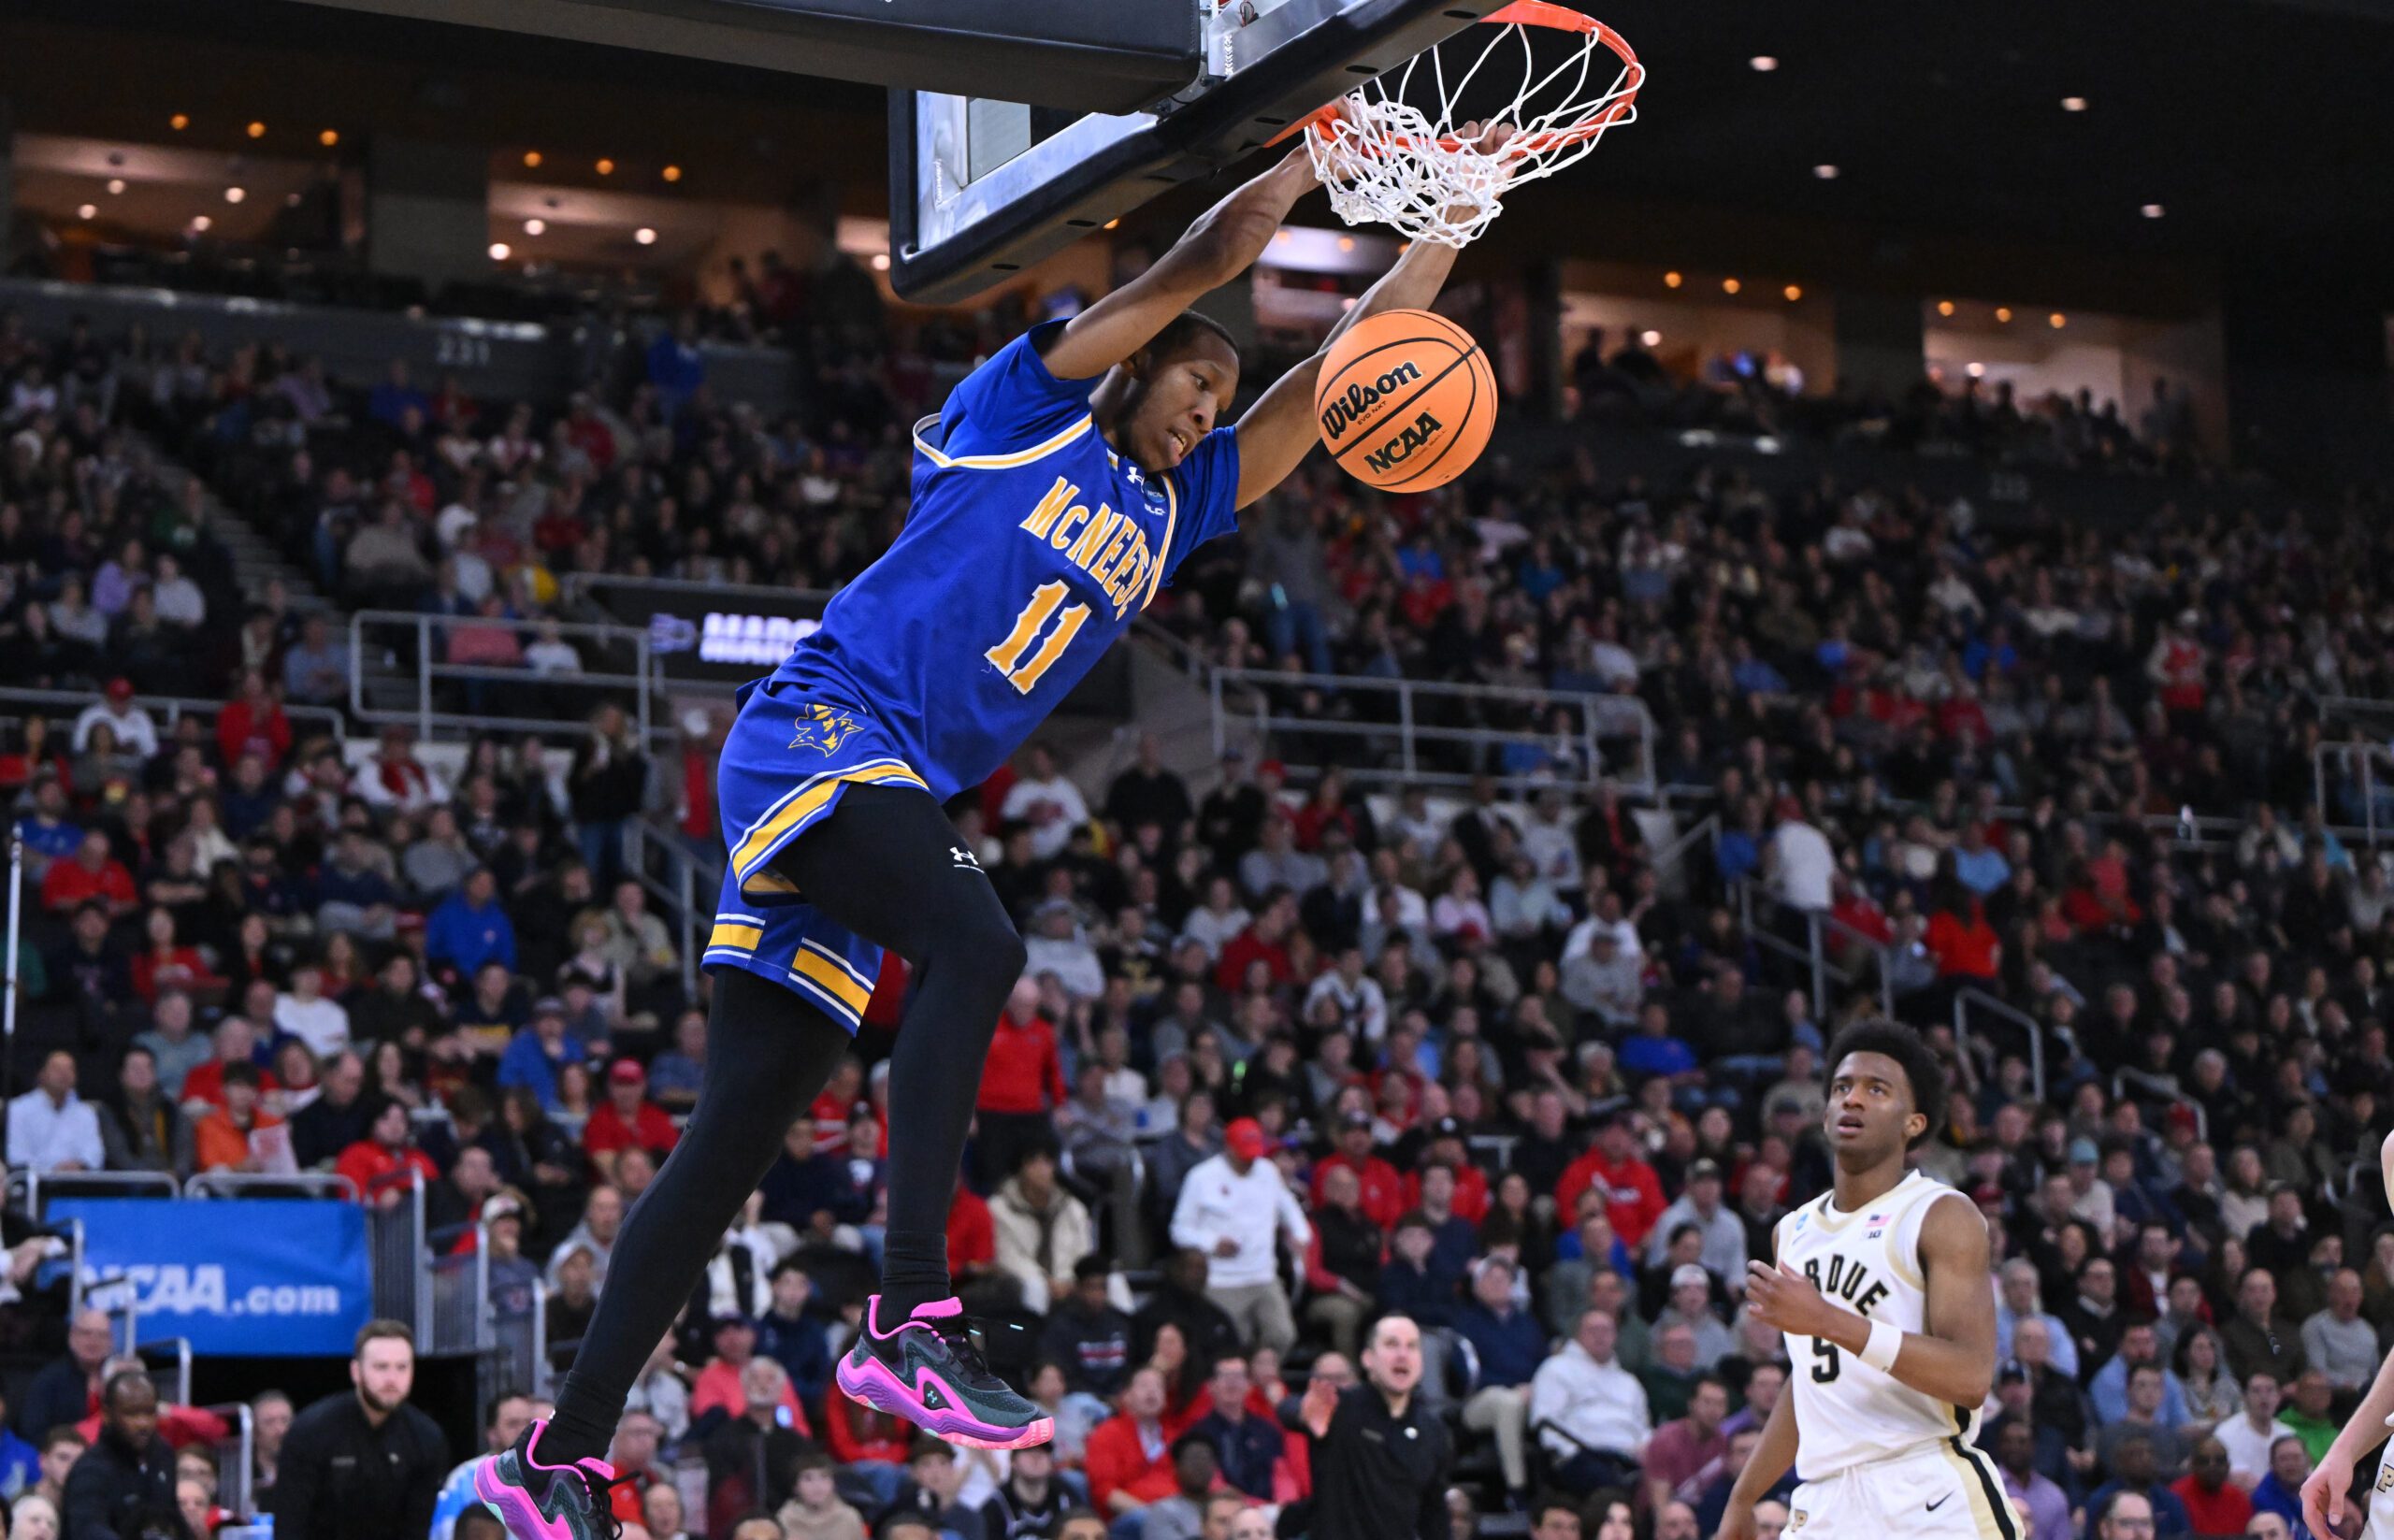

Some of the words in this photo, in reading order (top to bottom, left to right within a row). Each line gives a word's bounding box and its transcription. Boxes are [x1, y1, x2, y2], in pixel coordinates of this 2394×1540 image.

[1321, 361, 1422, 439] Wilson
[1363, 411, 1443, 474] NCAA
[984, 579, 1092, 695] 11
[1805, 1254, 1889, 1317] RDUE
[1811, 1335, 1840, 1384] 5
